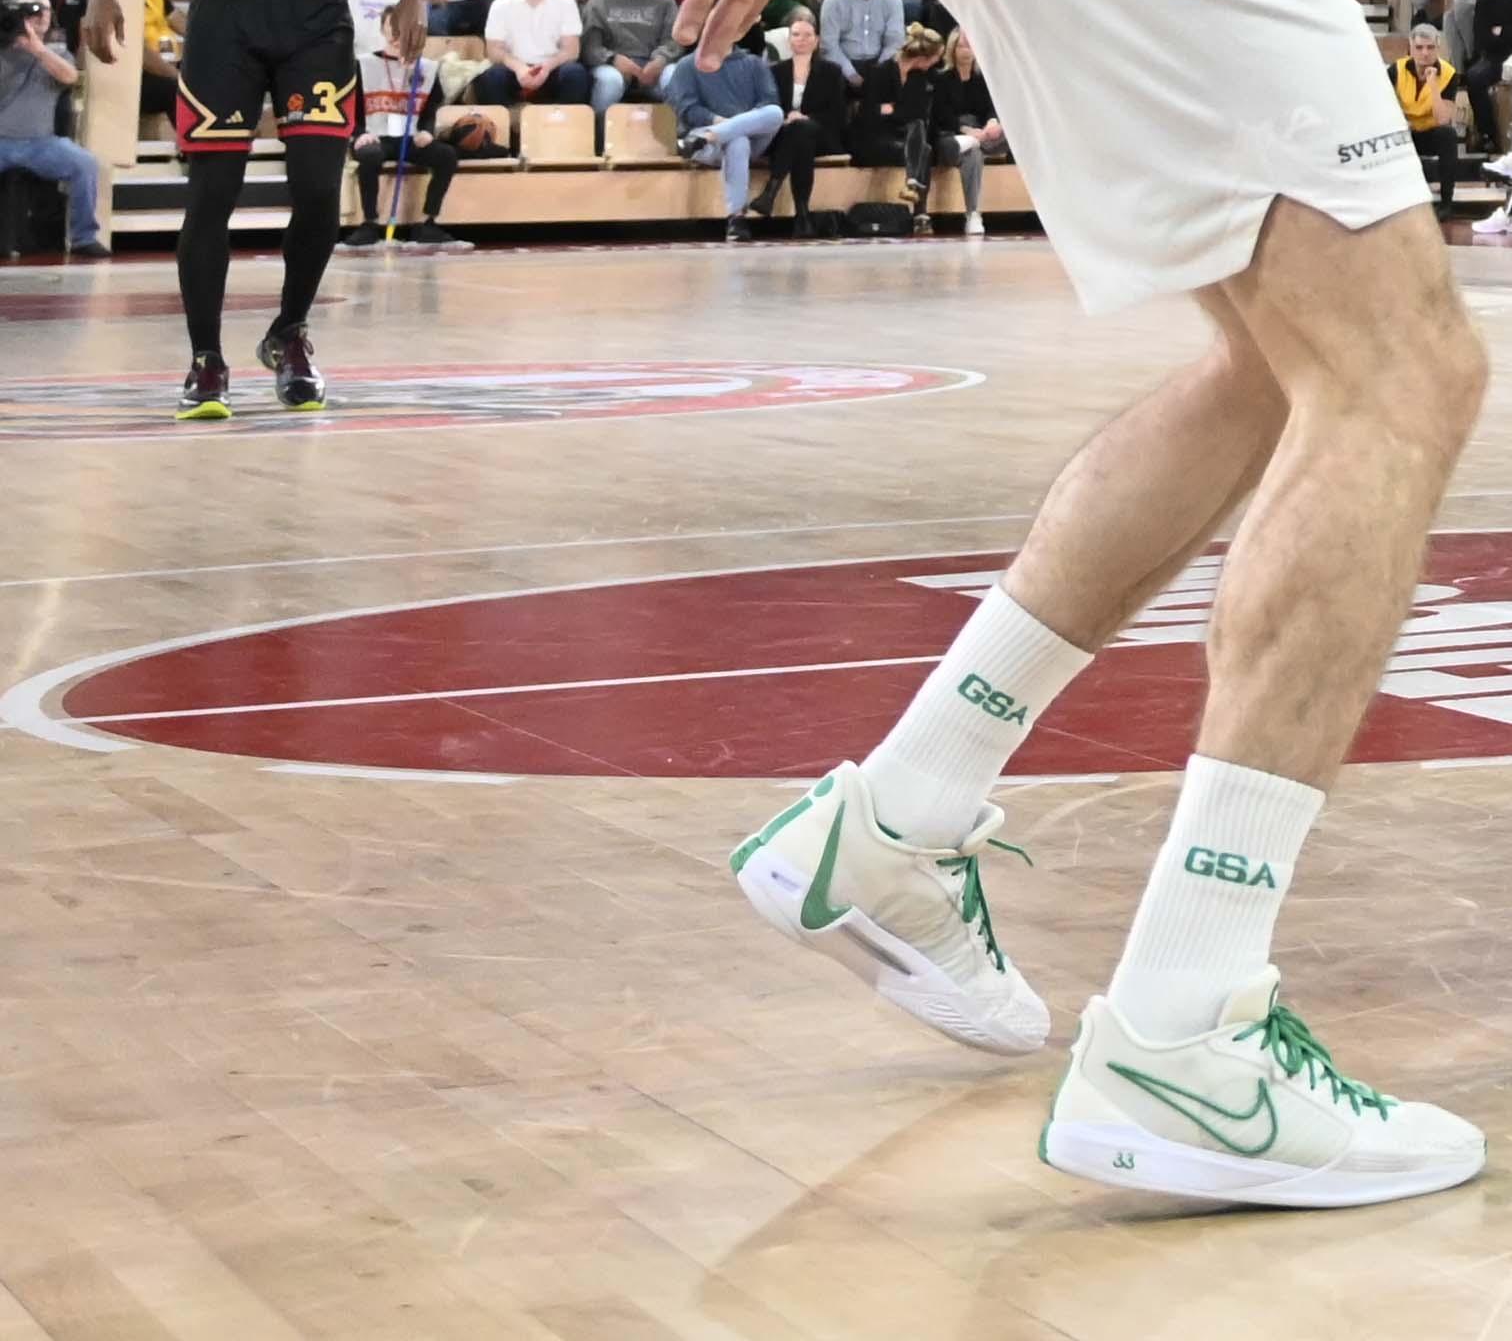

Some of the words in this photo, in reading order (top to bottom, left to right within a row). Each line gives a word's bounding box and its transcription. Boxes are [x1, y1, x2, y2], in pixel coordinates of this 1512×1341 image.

[311, 80, 338, 114] 3
[957, 672, 1029, 727] GSA
[1184, 845, 1277, 890] GSA
[1112, 1151, 1136, 1170] 33
